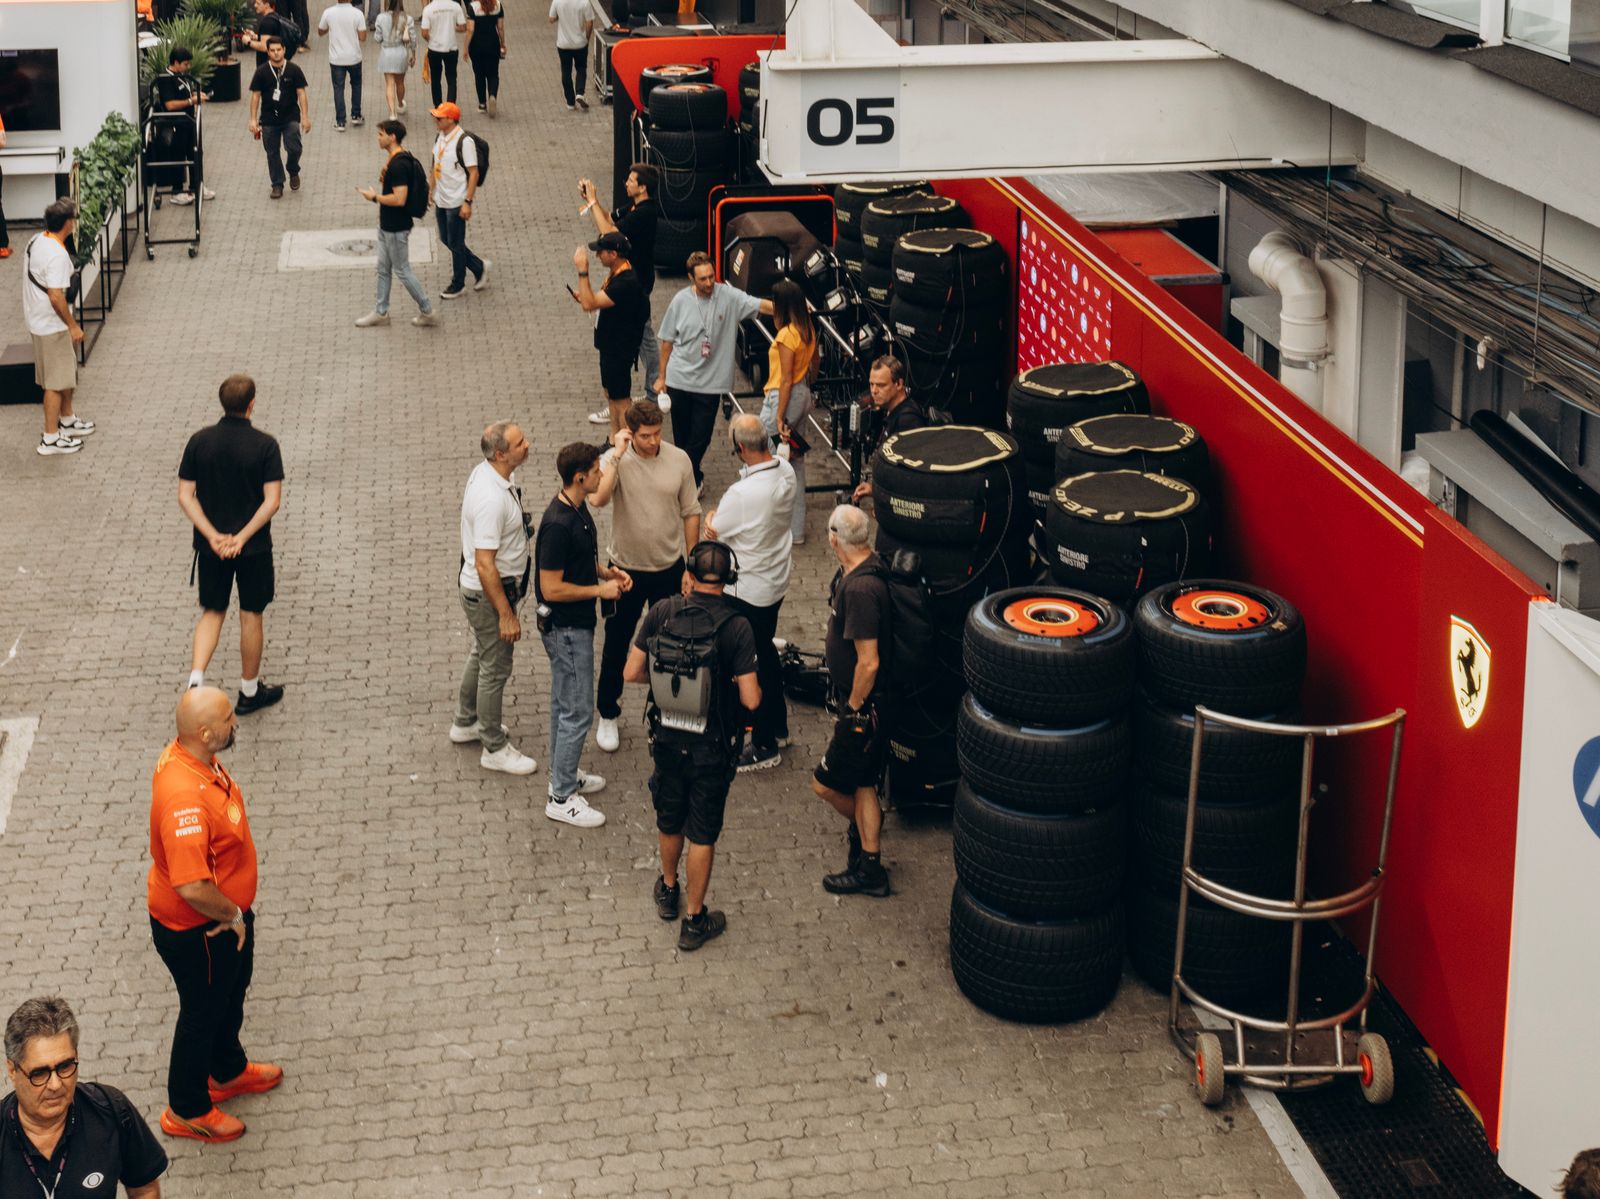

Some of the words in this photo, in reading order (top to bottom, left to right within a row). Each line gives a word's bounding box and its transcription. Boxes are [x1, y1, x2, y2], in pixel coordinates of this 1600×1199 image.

[807, 97, 894, 146] 05
[890, 496, 925, 512] ANTERIORE
[893, 506, 922, 519] SINISTRO
[1057, 544, 1089, 563] ANTERIORE
[1060, 554, 1086, 570] SINISTRO
